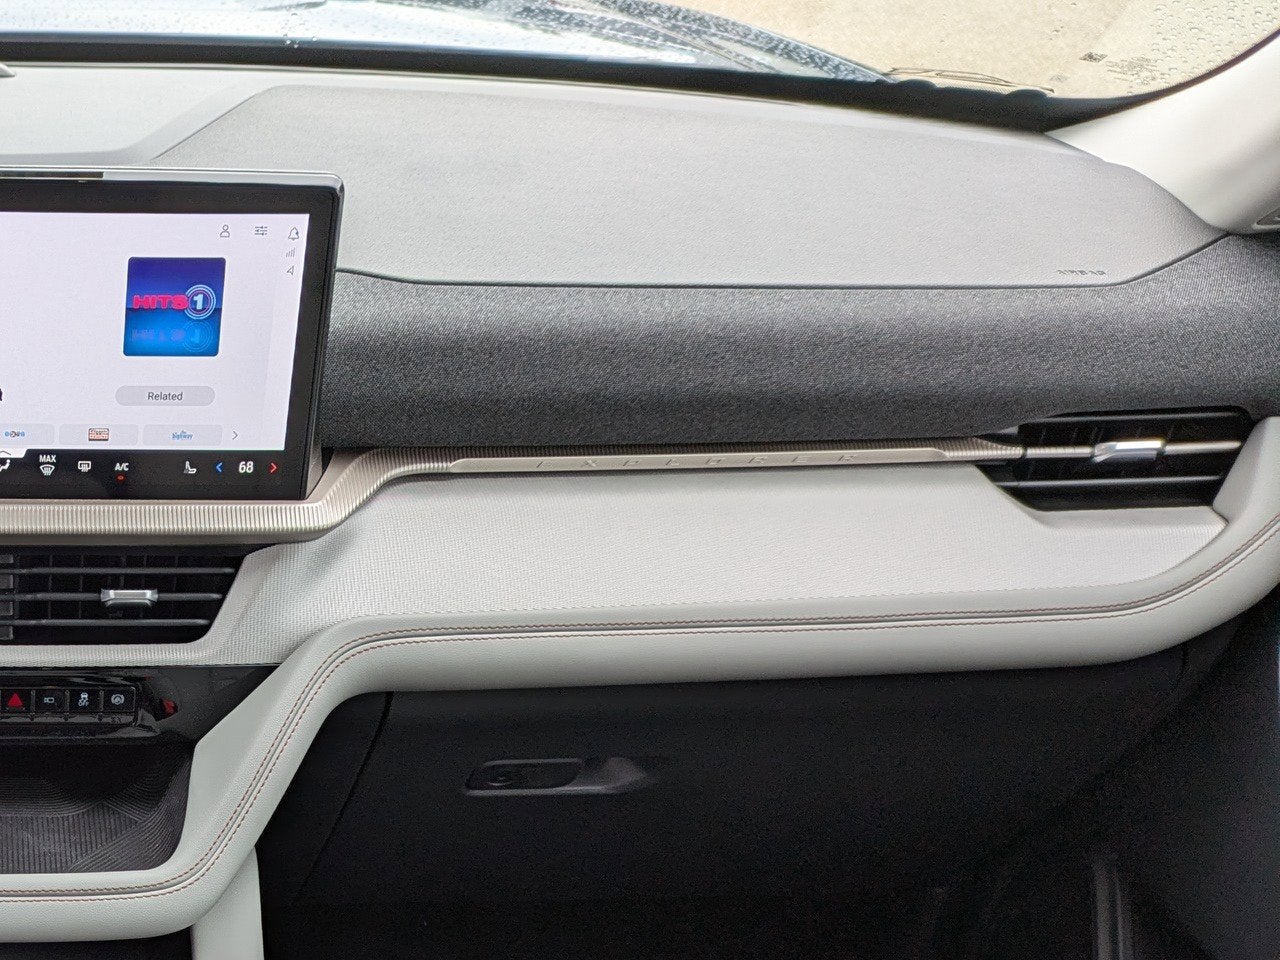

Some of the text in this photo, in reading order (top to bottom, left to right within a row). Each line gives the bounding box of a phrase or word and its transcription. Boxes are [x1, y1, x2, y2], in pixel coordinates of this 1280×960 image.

[132, 294, 189, 311] HITS
[147, 391, 183, 401] Related
[39, 454, 57, 463] MAX
[114, 462, 129, 472] A/C
[238, 461, 254, 473] 68
[78, 699, 90, 707] OFF
